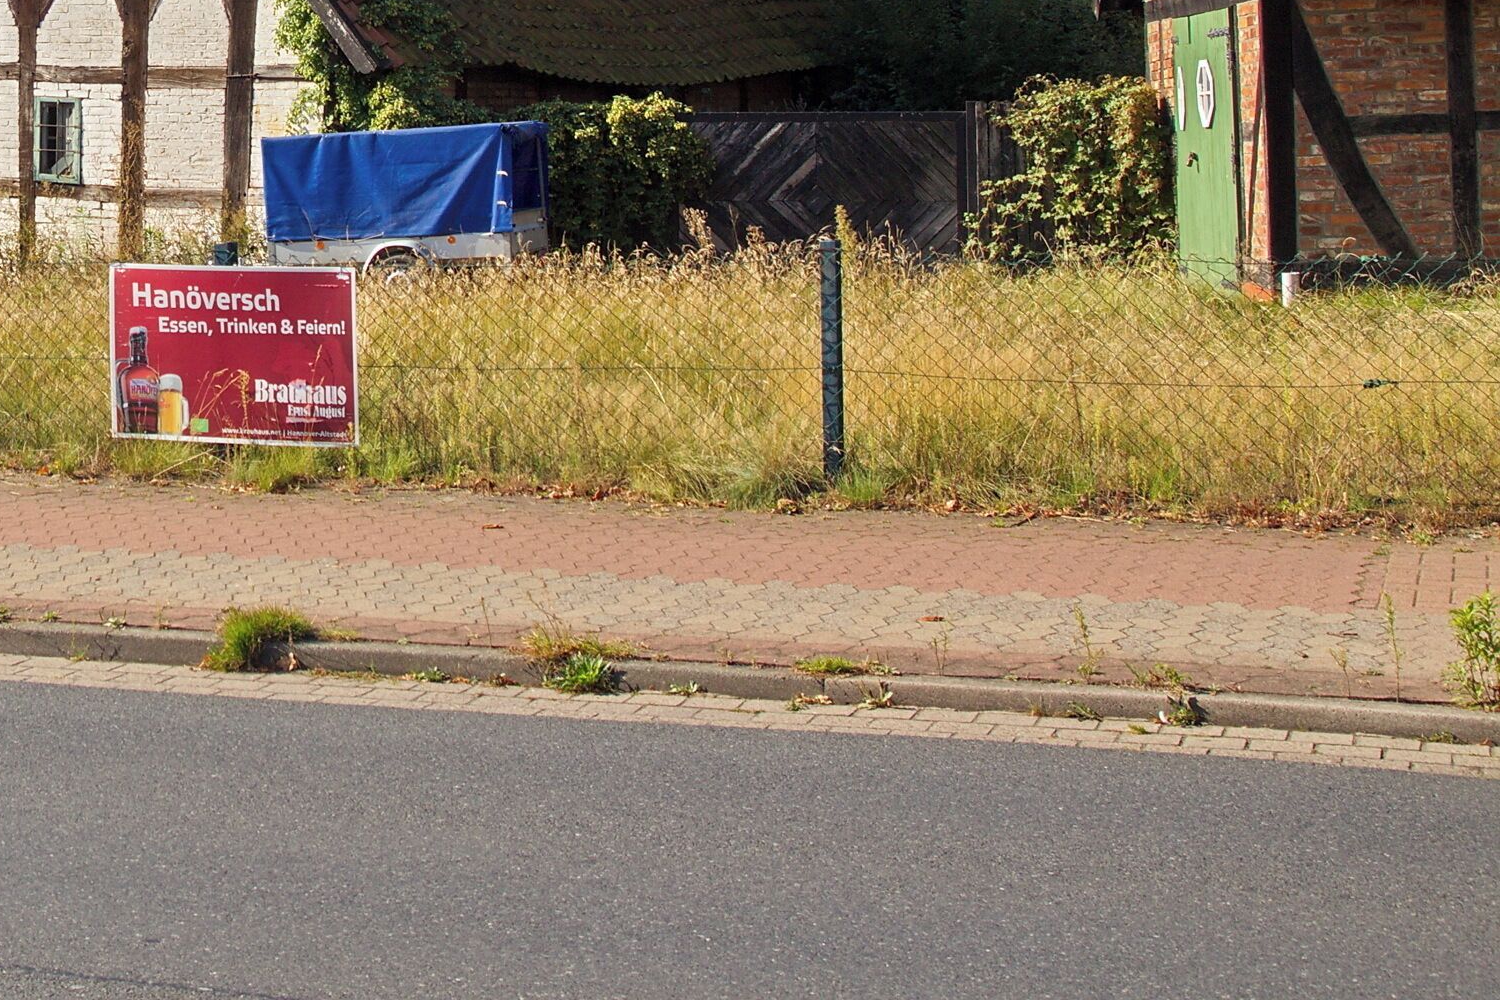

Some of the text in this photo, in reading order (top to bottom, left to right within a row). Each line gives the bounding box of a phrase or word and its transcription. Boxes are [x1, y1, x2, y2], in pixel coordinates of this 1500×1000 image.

[132, 282, 280, 312] Hanöversch
[158, 316, 346, 336] Essen, Trinken & Feiern!
[255, 378, 347, 405] Brauhaus
[287, 404, 346, 418] Ernst August
